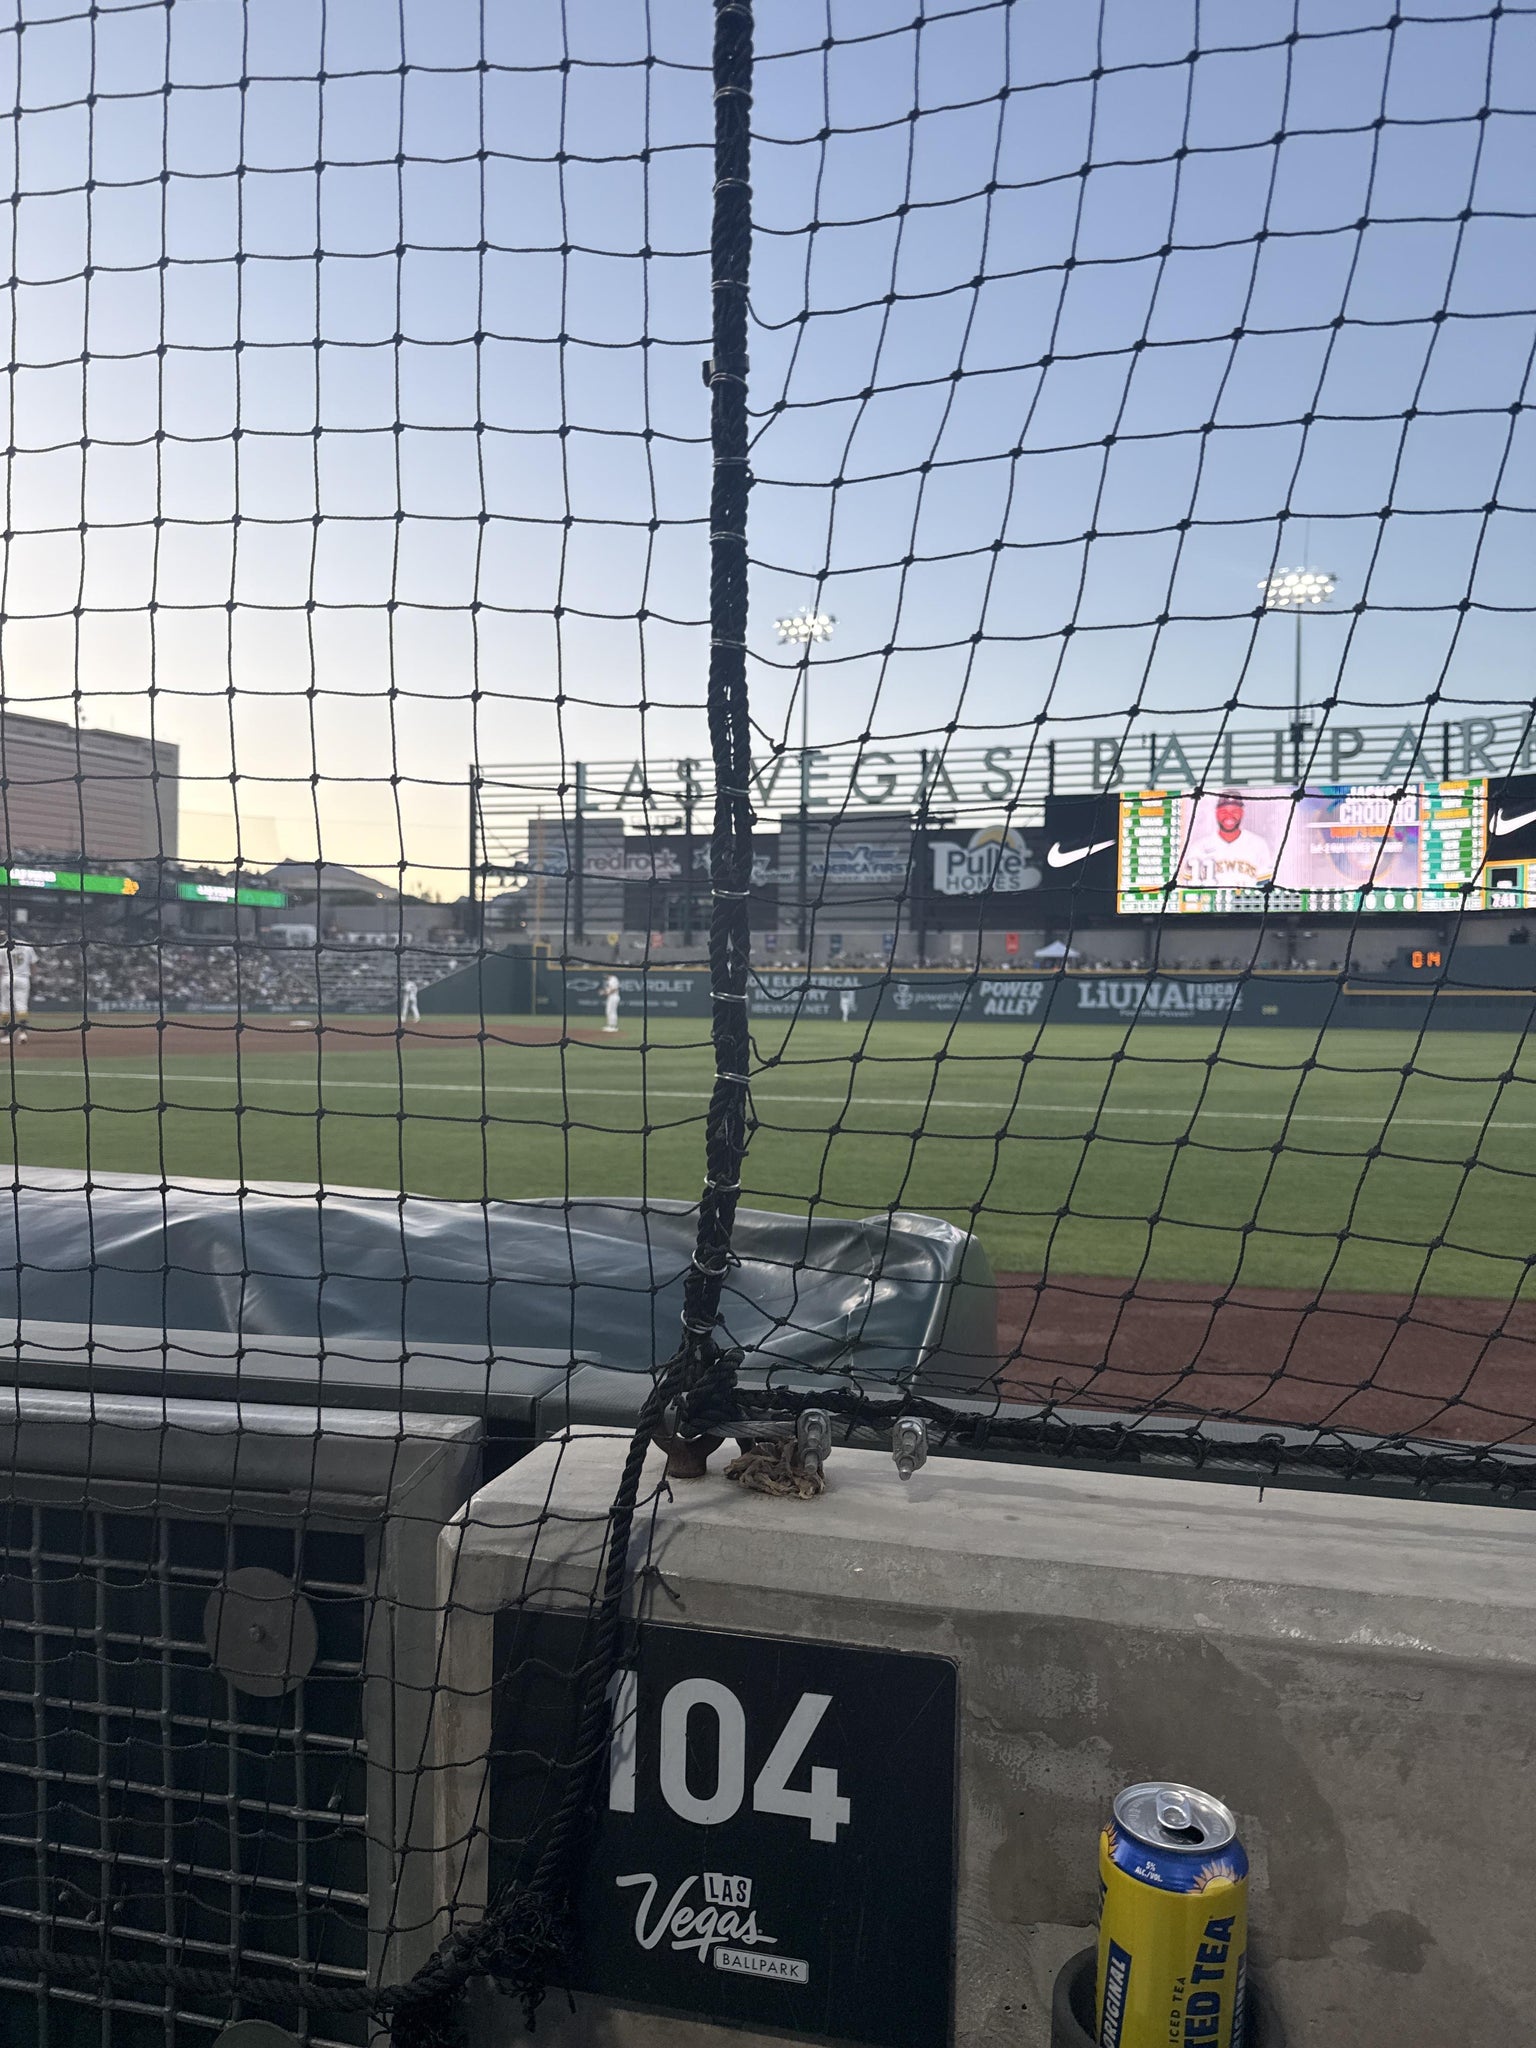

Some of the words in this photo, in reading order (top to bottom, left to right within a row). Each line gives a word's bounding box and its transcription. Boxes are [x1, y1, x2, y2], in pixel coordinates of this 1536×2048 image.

[577, 759, 702, 811] LAS
[749, 746, 1013, 807] VEGAS
[612, 979, 693, 992] HEVROLET
[979, 981, 1043, 998] POWER
[984, 999, 1038, 1015] ALLEY
[605, 1669, 851, 1844] 104
[1146, 1861, 1156, 1872] 5%
[708, 1876, 747, 1902] LAS
[615, 1872, 778, 1964] Vegas
[1190, 1914, 1237, 1985] TEA
[722, 1953, 800, 1978] BALLPARK
[1102, 1955, 1126, 2048] ORIGINAL
[1172, 1976, 1186, 2002] TEA
[1169, 2009, 1180, 2043] ICED
